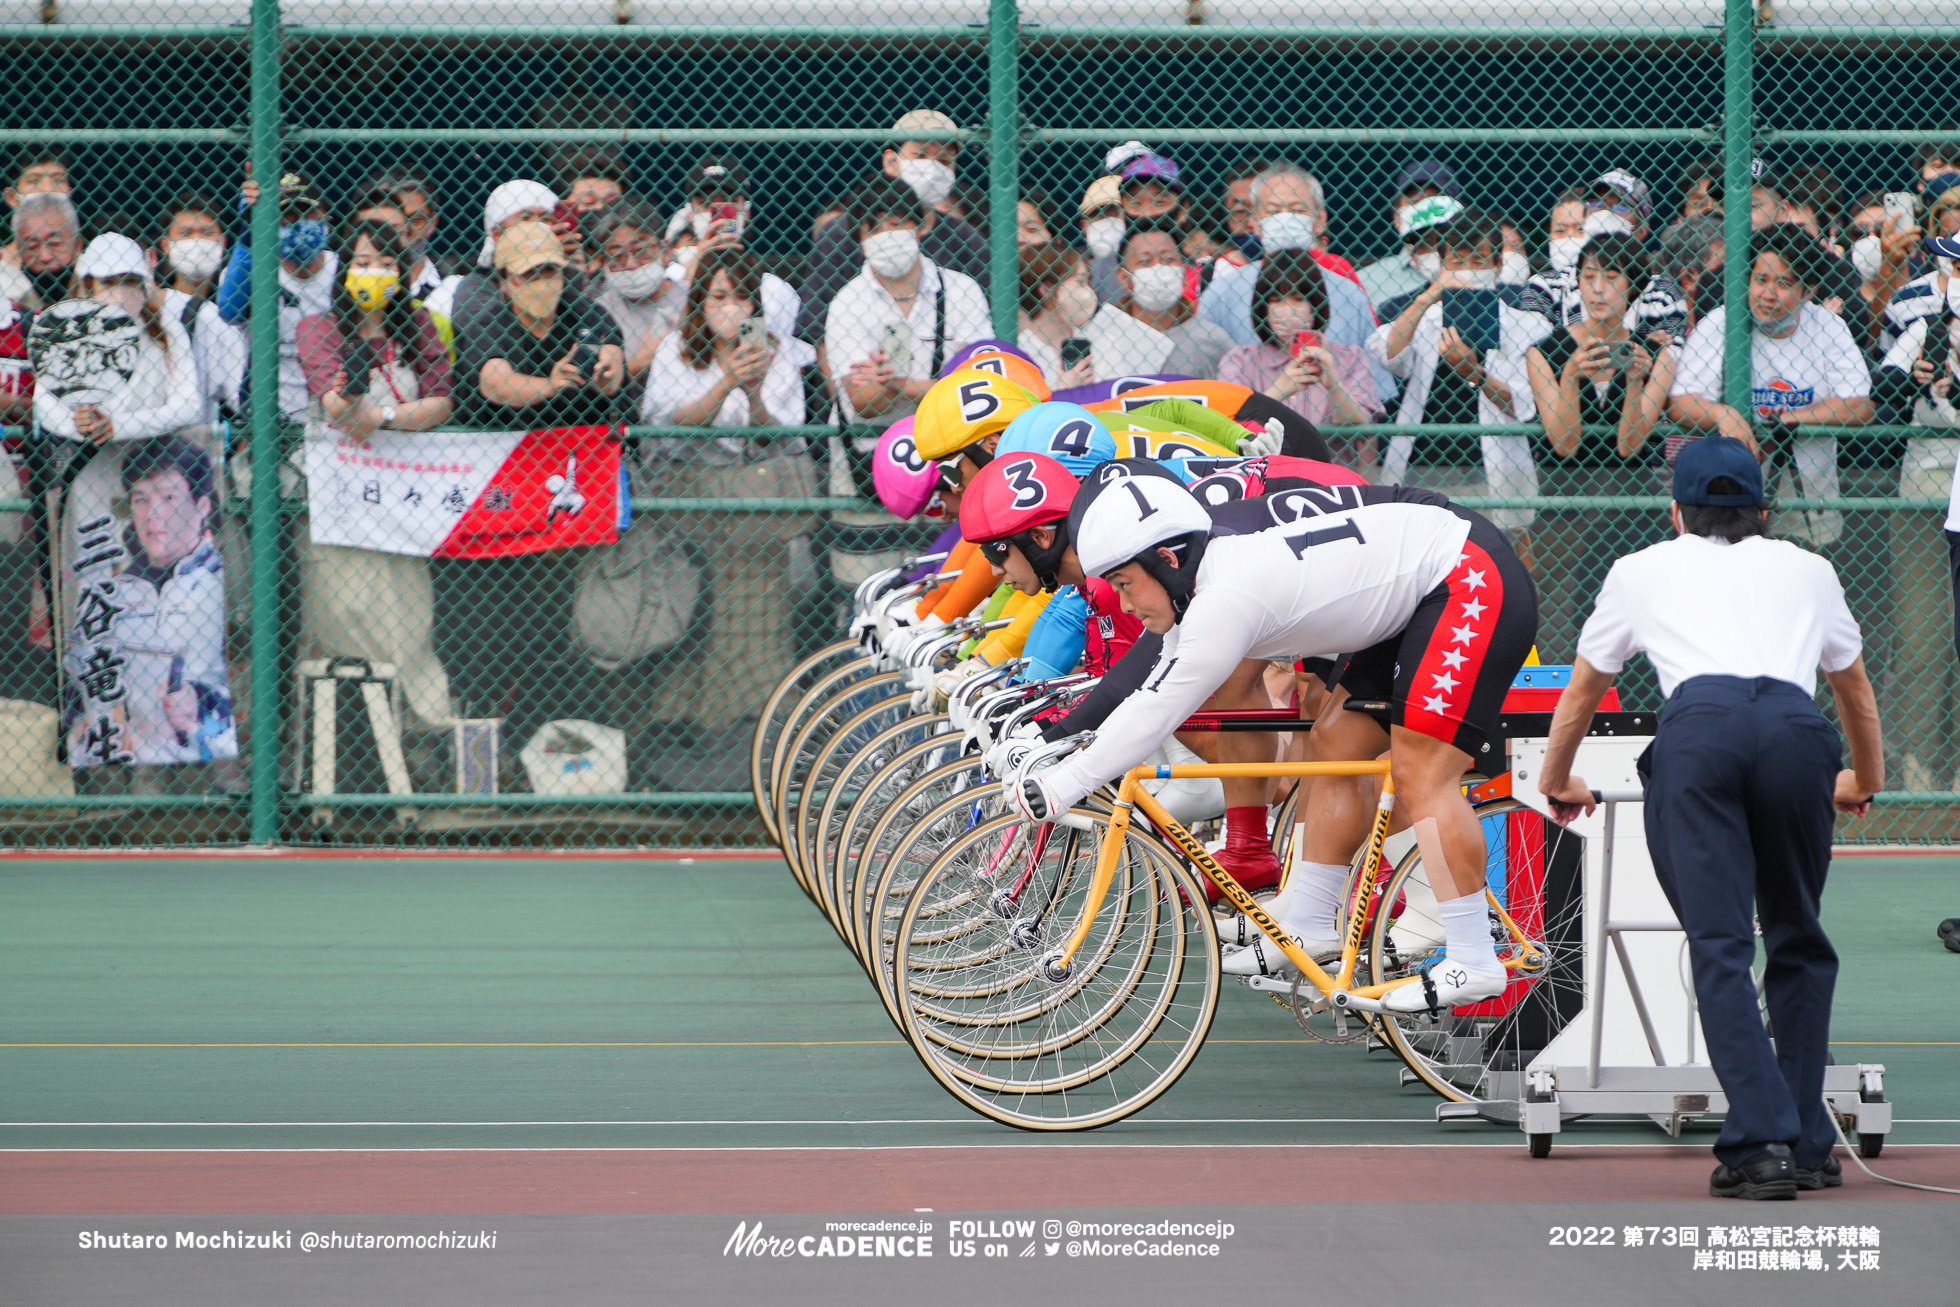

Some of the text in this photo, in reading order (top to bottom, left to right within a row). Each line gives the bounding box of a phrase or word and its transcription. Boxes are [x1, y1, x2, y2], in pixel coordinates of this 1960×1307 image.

[957, 379, 1001, 424] 5
[888, 434, 932, 475] 8
[1048, 417, 1097, 458] 4
[362, 478, 514, 513] 日々感謝
[1002, 457, 1047, 511] 3
[1121, 480, 1159, 522] 1
[1283, 517, 1367, 561] 1
[72, 514, 134, 767] 三谷竜生
[1165, 822, 1294, 949] BRIDGESTONE
[1349, 809, 1390, 950] BRIDGESTONE
